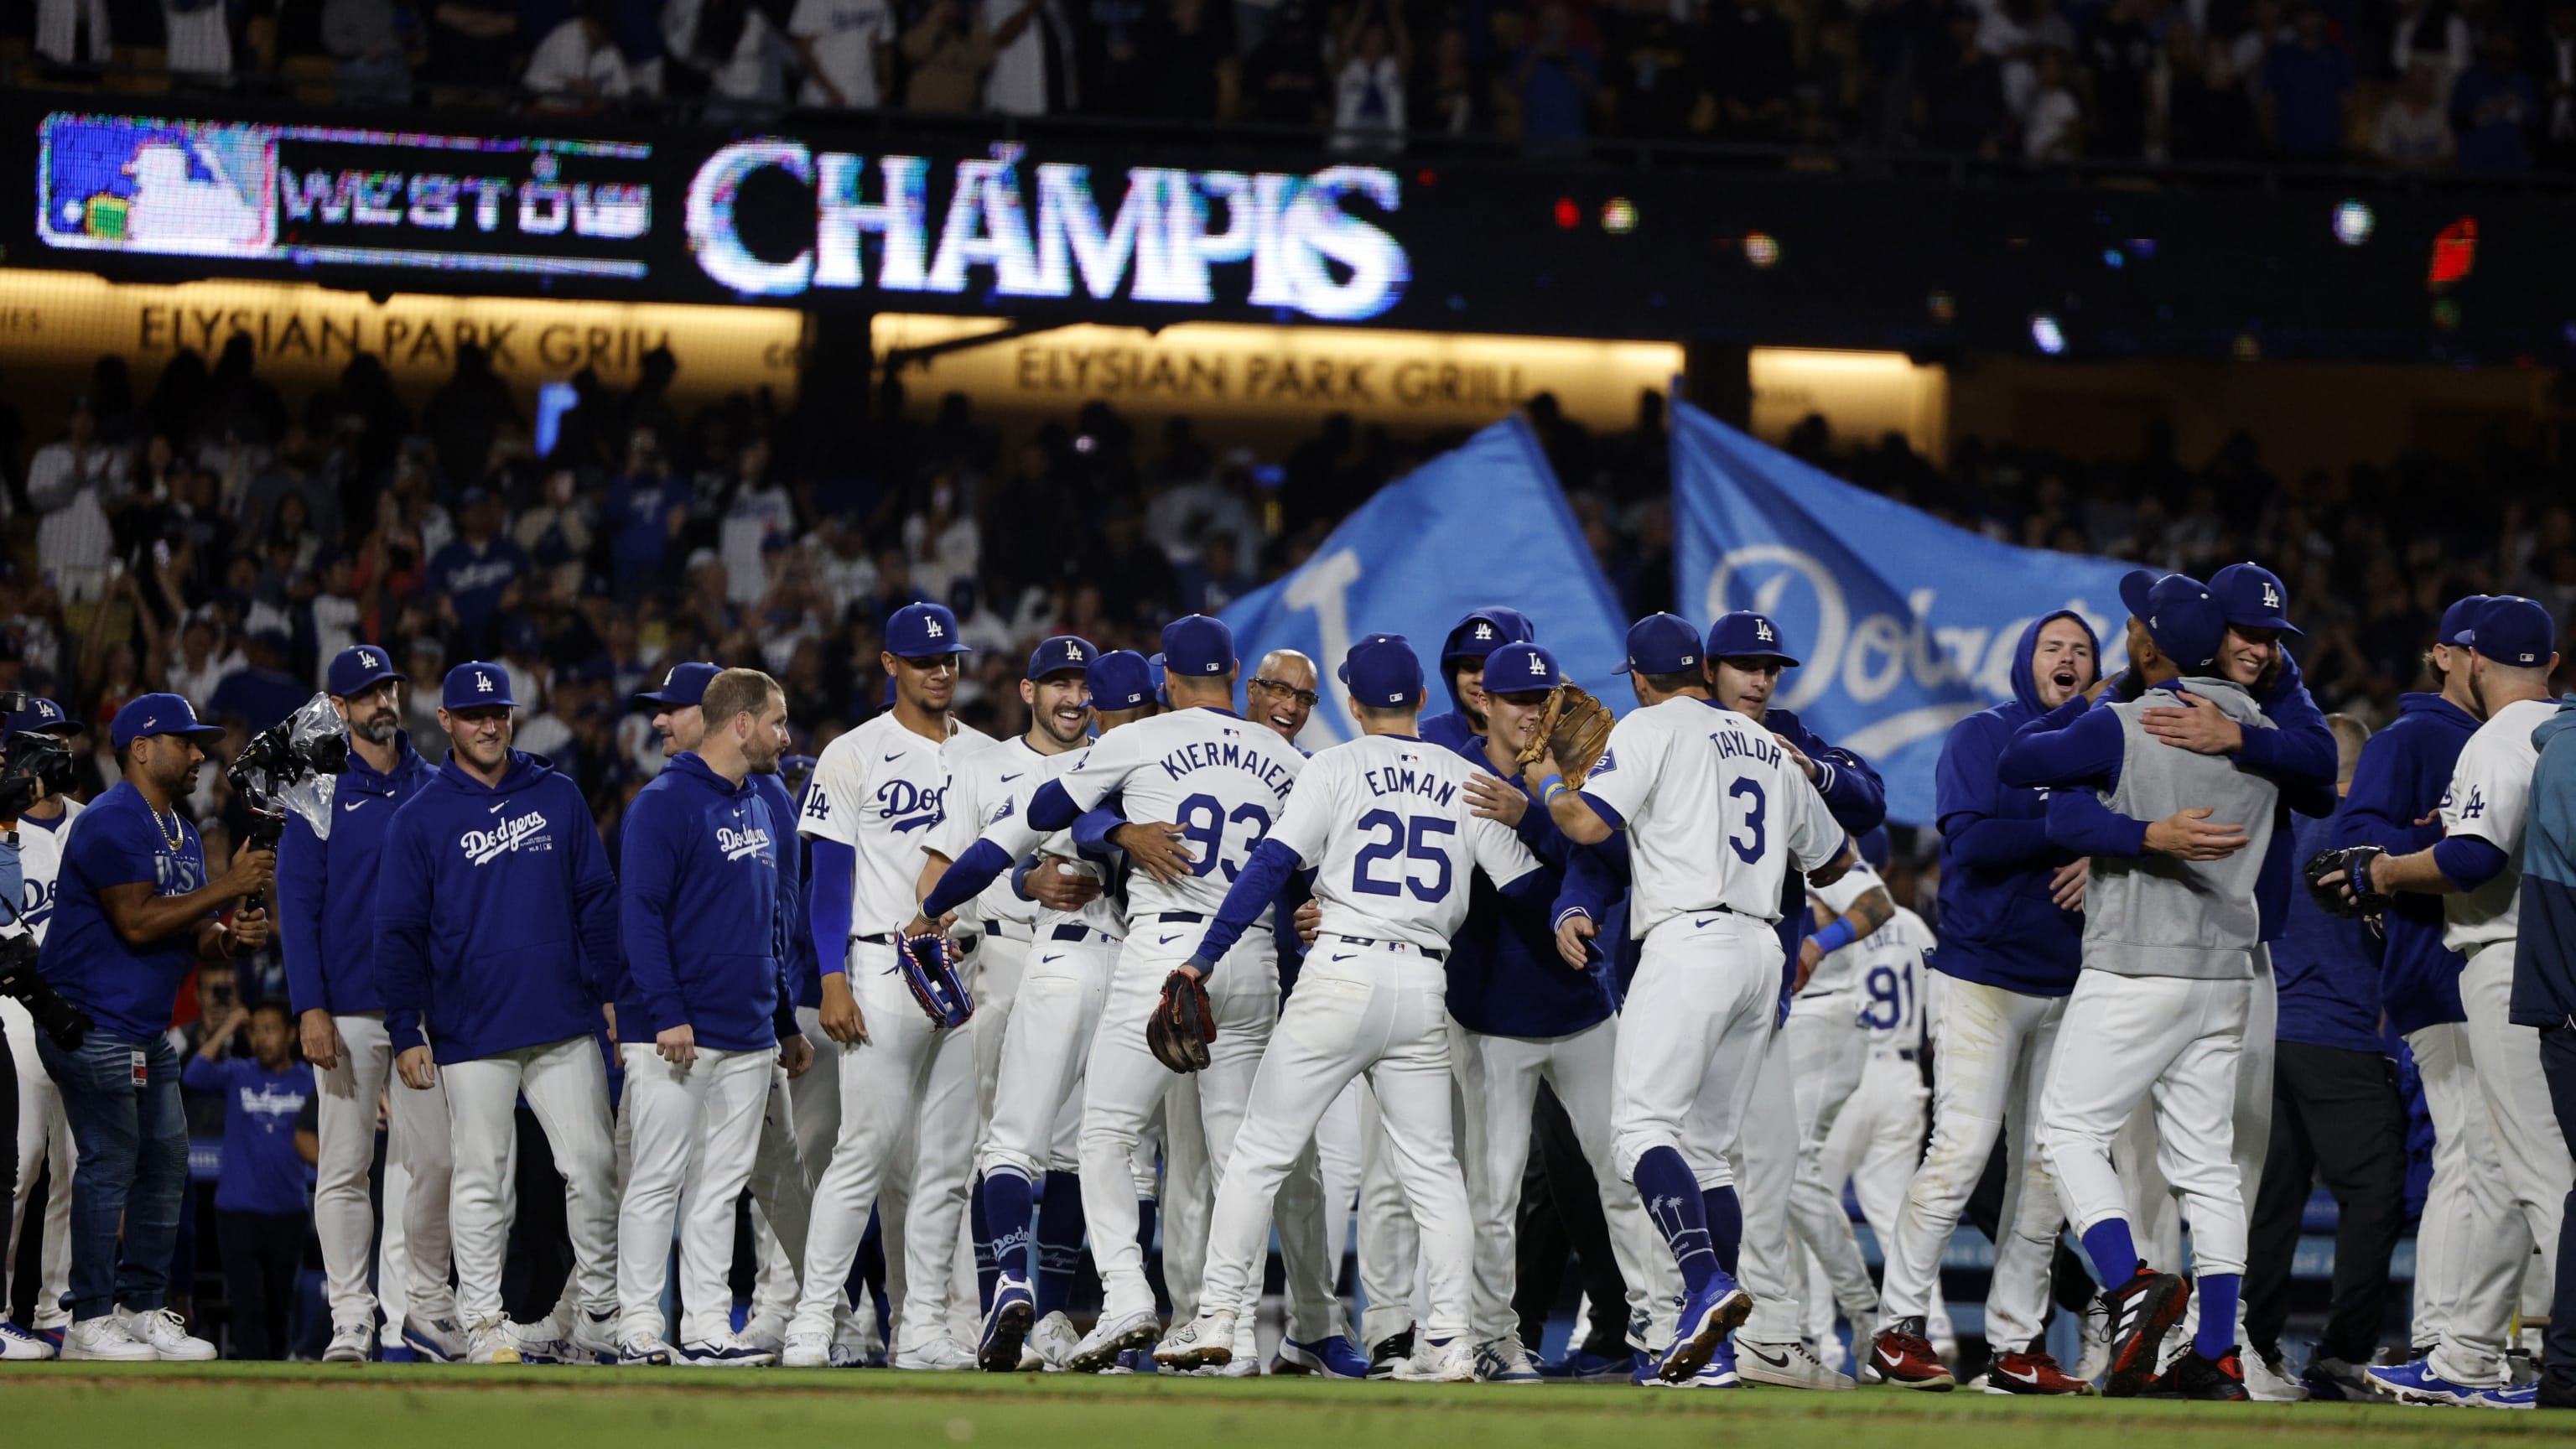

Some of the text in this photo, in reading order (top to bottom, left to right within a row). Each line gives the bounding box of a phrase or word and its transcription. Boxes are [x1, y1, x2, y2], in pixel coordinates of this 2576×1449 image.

[140, 305, 362, 358] ELYSIAN
[383, 316, 520, 367] PARK
[1018, 346, 1528, 407] ELYSIAN PARK GRILL
[2262, 582, 2279, 607] LA
[925, 615, 943, 637] LA
[1476, 623, 1492, 640] LA
[1755, 619, 1773, 641] LA
[357, 650, 378, 668] LA
[1066, 640, 1083, 661] LA
[1528, 652, 1546, 675] LA
[475, 671, 493, 692] LA
[35, 700, 55, 717] LA
[1709, 730, 1782, 770] TAYLOR
[1160, 742, 1294, 802] KIERMAIER
[1365, 766, 1457, 808] EDMAN
[807, 783, 830, 820] LA
[1728, 776, 1766, 865] 3
[460, 811, 548, 865] Dodgers
[717, 823, 770, 862] Dodgers
[1176, 792, 1272, 883] 93
[1352, 808, 1457, 904] 25
[1867, 961, 1914, 1030] 91
